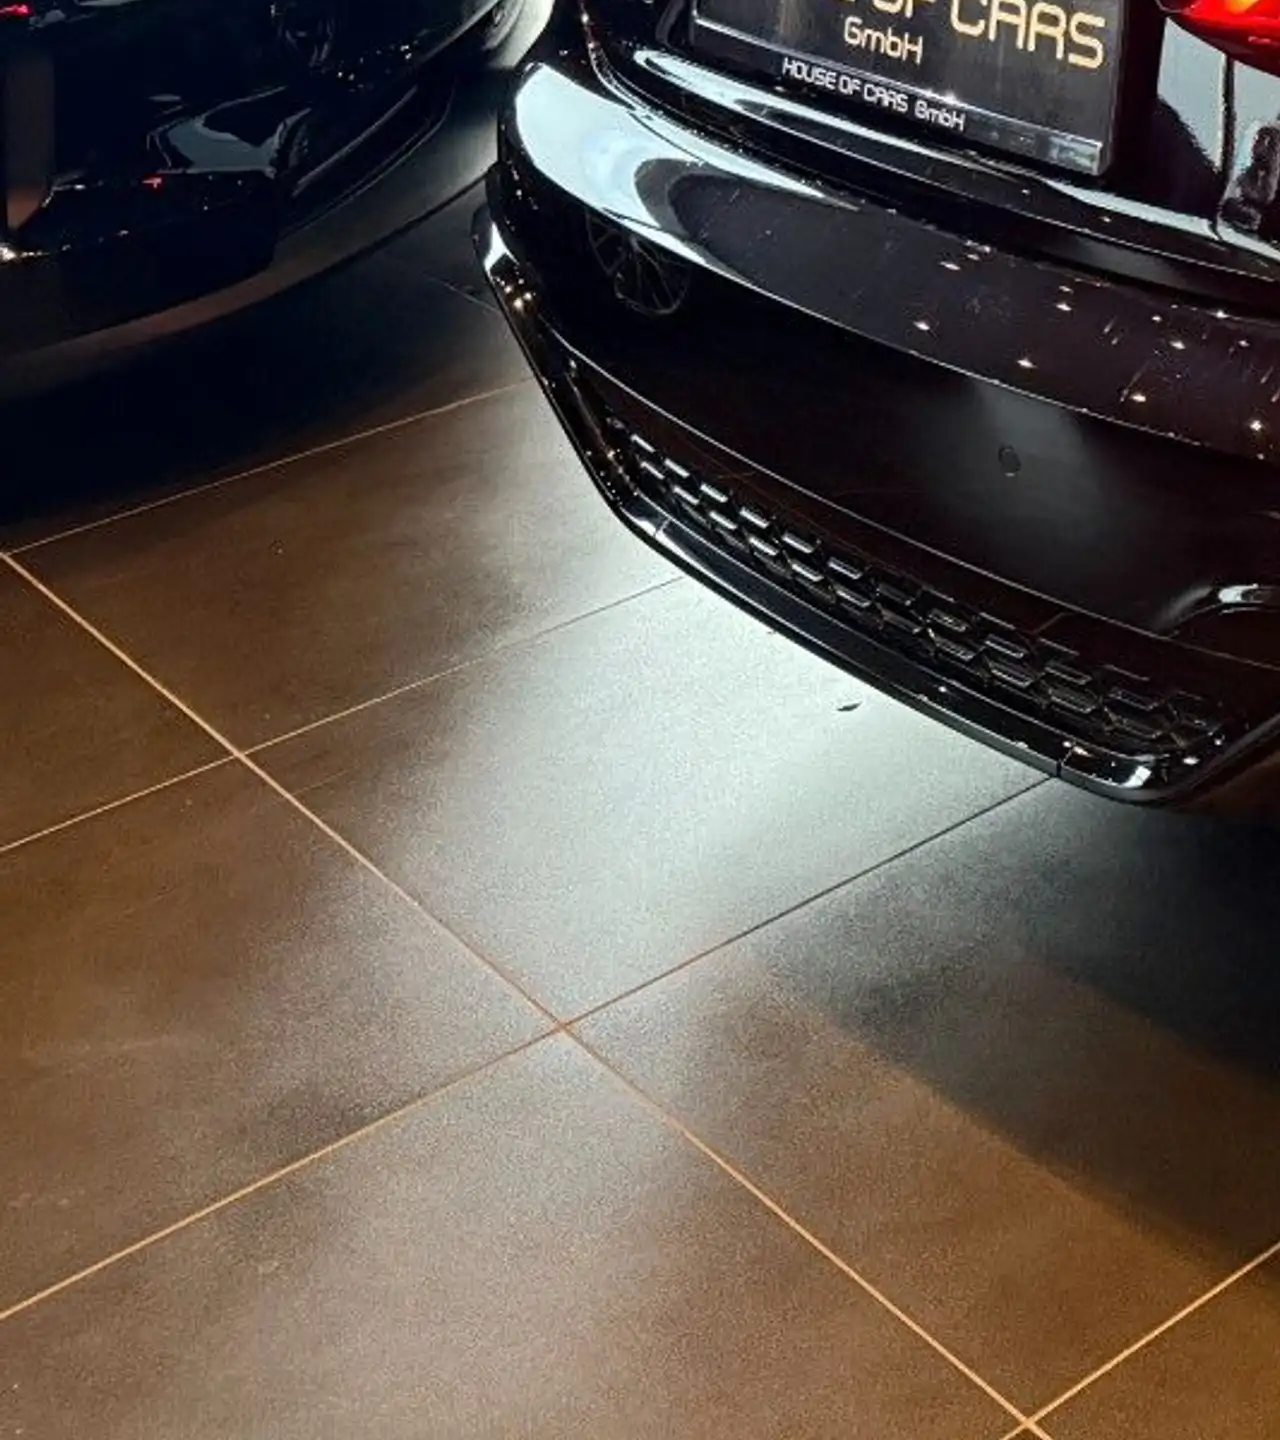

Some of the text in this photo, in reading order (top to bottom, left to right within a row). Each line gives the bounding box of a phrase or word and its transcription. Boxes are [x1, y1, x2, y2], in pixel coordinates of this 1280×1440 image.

[843, 15, 924, 65] GmbH
[782, 57, 966, 132] HOUSE OF CARS GmbH
